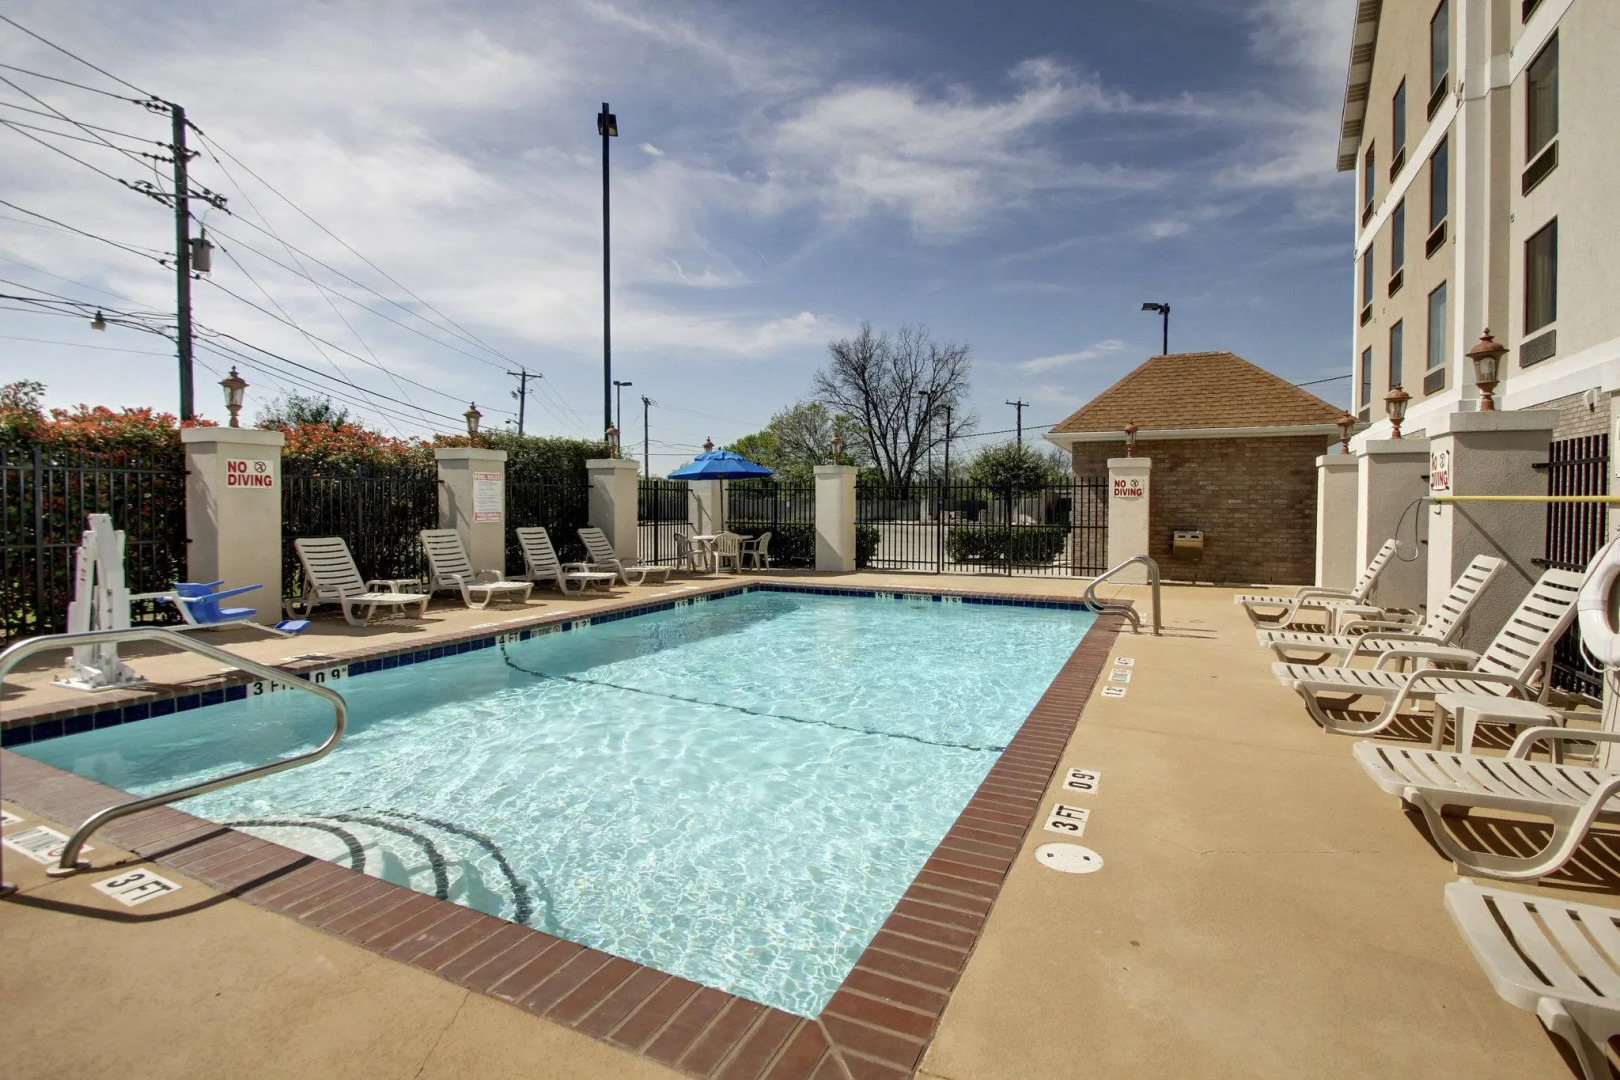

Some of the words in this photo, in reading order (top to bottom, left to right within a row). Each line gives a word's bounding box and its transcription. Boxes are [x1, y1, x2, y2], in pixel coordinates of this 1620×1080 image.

[227, 461, 247, 473] NO
[1432, 456, 1438, 471] NO
[227, 474, 272, 486] DIVING
[1114, 480, 1126, 488] NO
[1432, 471, 1448, 486] DIVING
[1114, 488, 1142, 496] DIVING
[499, 634, 505, 643] 4
[508, 632, 519, 643] FT
[253, 682, 263, 695] 3
[1056, 805, 1085, 820] FT
[1051, 821, 1079, 831] 3
[107, 873, 145, 888] 3
[120, 880, 173, 901] FT
